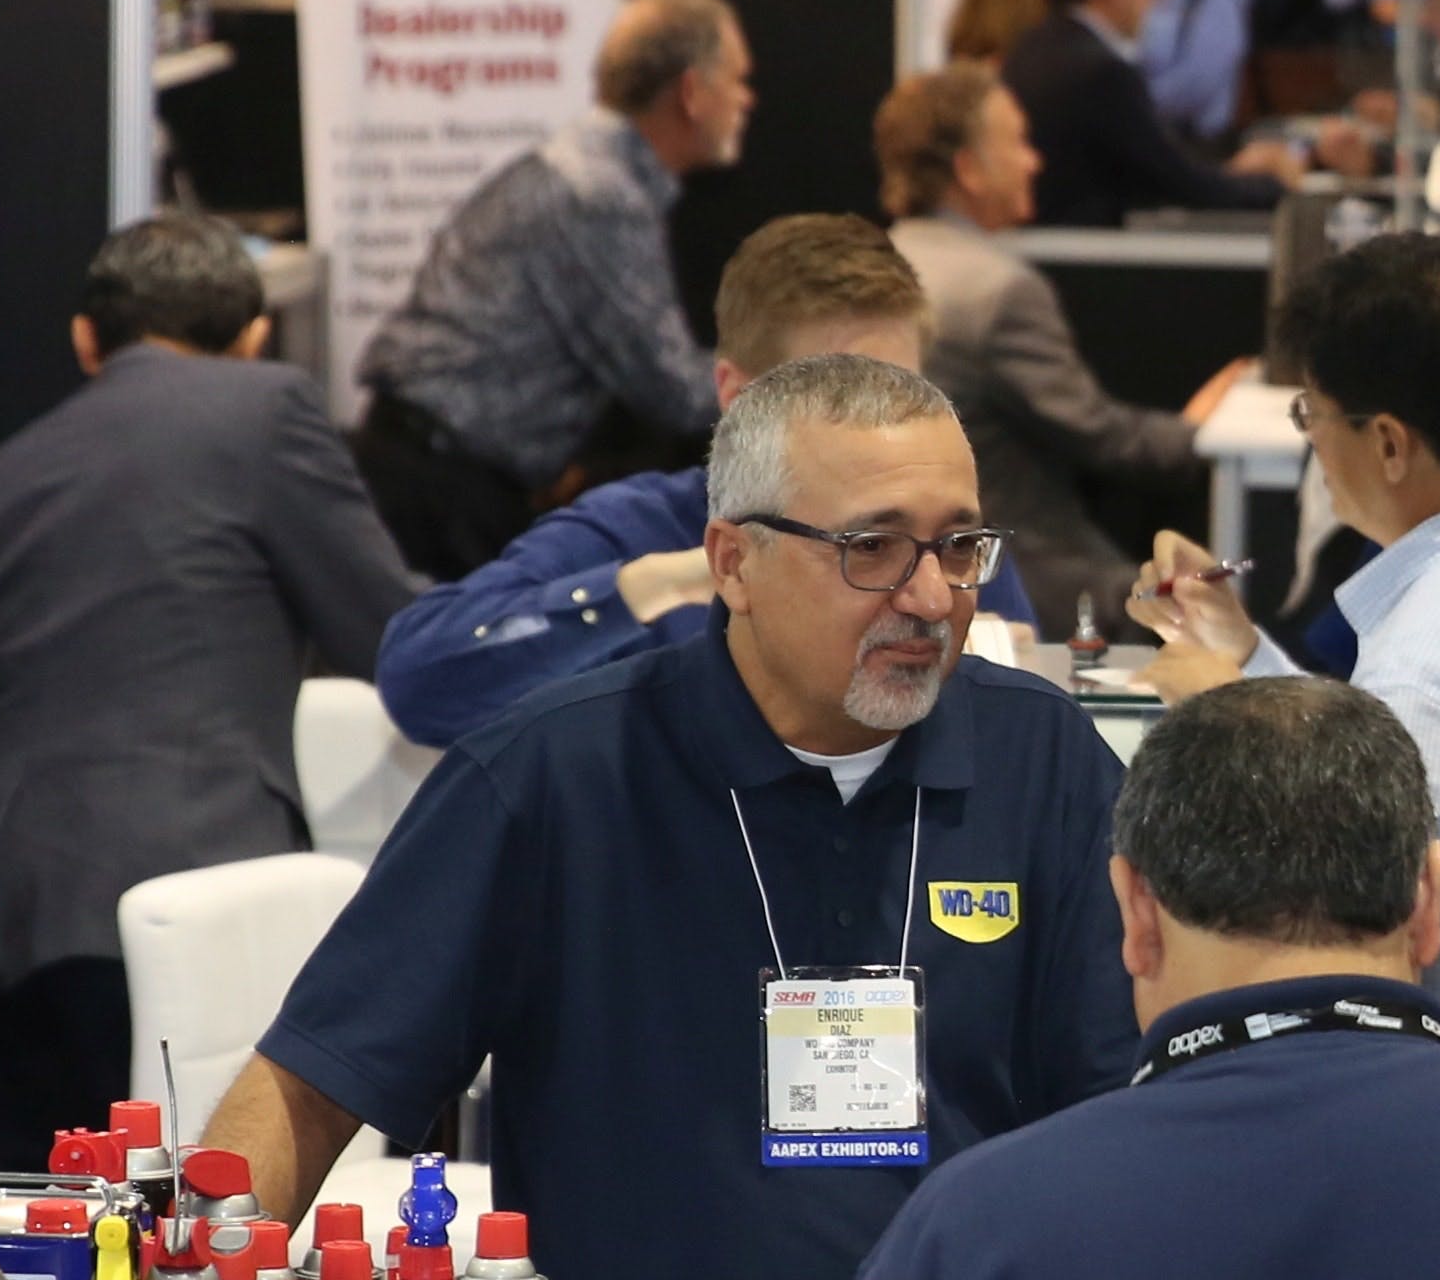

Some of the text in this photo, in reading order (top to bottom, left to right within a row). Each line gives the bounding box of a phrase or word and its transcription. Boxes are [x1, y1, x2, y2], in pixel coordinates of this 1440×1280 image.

[359, 0, 568, 45] Dealership
[363, 50, 562, 96] Programs
[938, 888, 1011, 918] WD-40
[773, 991, 817, 1003] SEMA
[824, 990, 856, 1006] 2016
[817, 1008, 865, 1023] ENRIQUE
[830, 1025, 852, 1037] DIAZ
[837, 1038, 877, 1049] COMPANY
[1168, 1023, 1225, 1057] aapex
[831, 1050, 858, 1062] IEGO,
[771, 1141, 920, 1158] AAPEX EXHIBITOR-16
